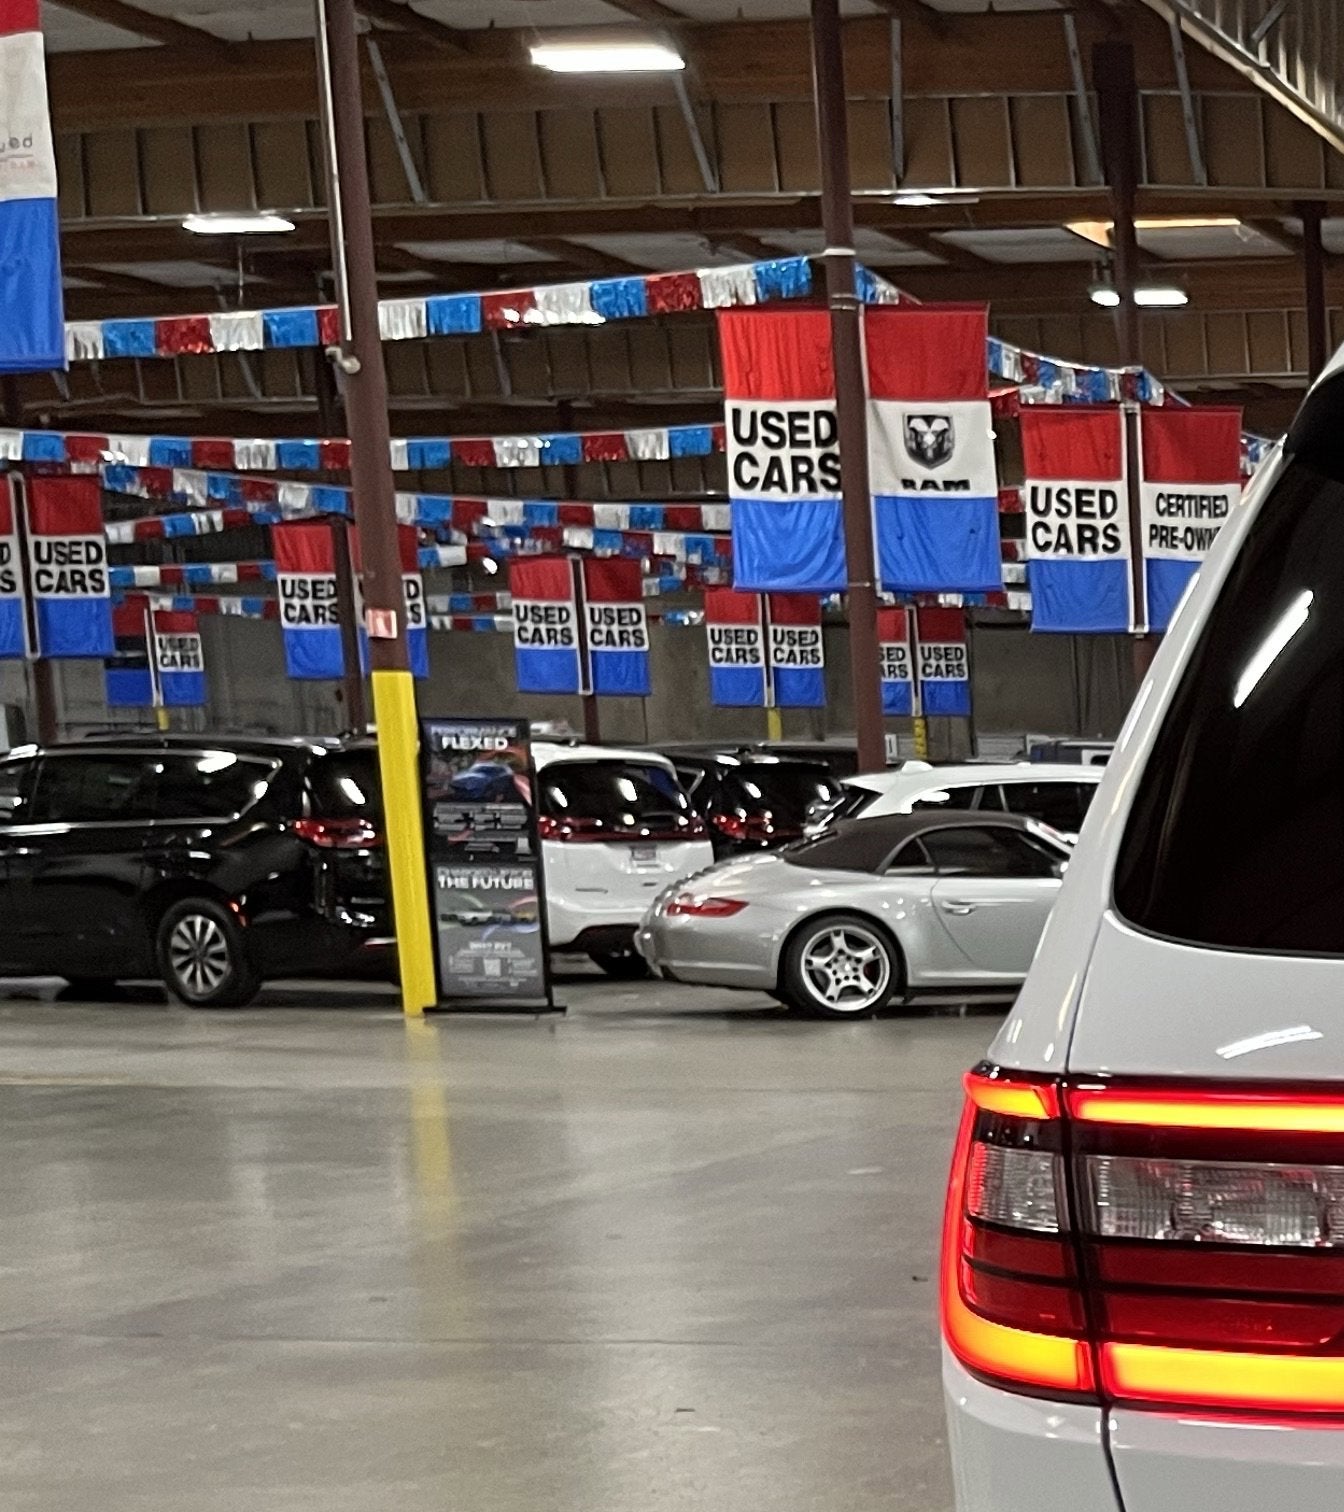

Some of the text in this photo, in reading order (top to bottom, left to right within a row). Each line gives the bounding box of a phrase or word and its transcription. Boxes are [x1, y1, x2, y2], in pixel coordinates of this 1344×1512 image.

[732, 408, 838, 449] USED
[733, 451, 841, 493] CARS
[901, 479, 971, 491] RAM
[1030, 486, 1118, 519] USED
[1155, 492, 1229, 518] CERTIFIED
[1031, 520, 1121, 553] CARS
[34, 540, 104, 566] USED
[35, 569, 106, 593] CARS
[281, 578, 337, 599] USED
[284, 603, 338, 624] CARS
[515, 604, 571, 624] USED
[590, 607, 642, 626] USED
[517, 626, 574, 645] CARS
[590, 628, 645, 647] CARS
[710, 628, 759, 646] USED
[773, 629, 819, 647] USED
[711, 647, 760, 664] CARS
[773, 648, 821, 665] CARS
[921, 646, 964, 662] USED
[921, 663, 966, 678] CARS
[441, 736, 509, 750] FLEXED
[438, 874, 534, 889] THE FUTURE
